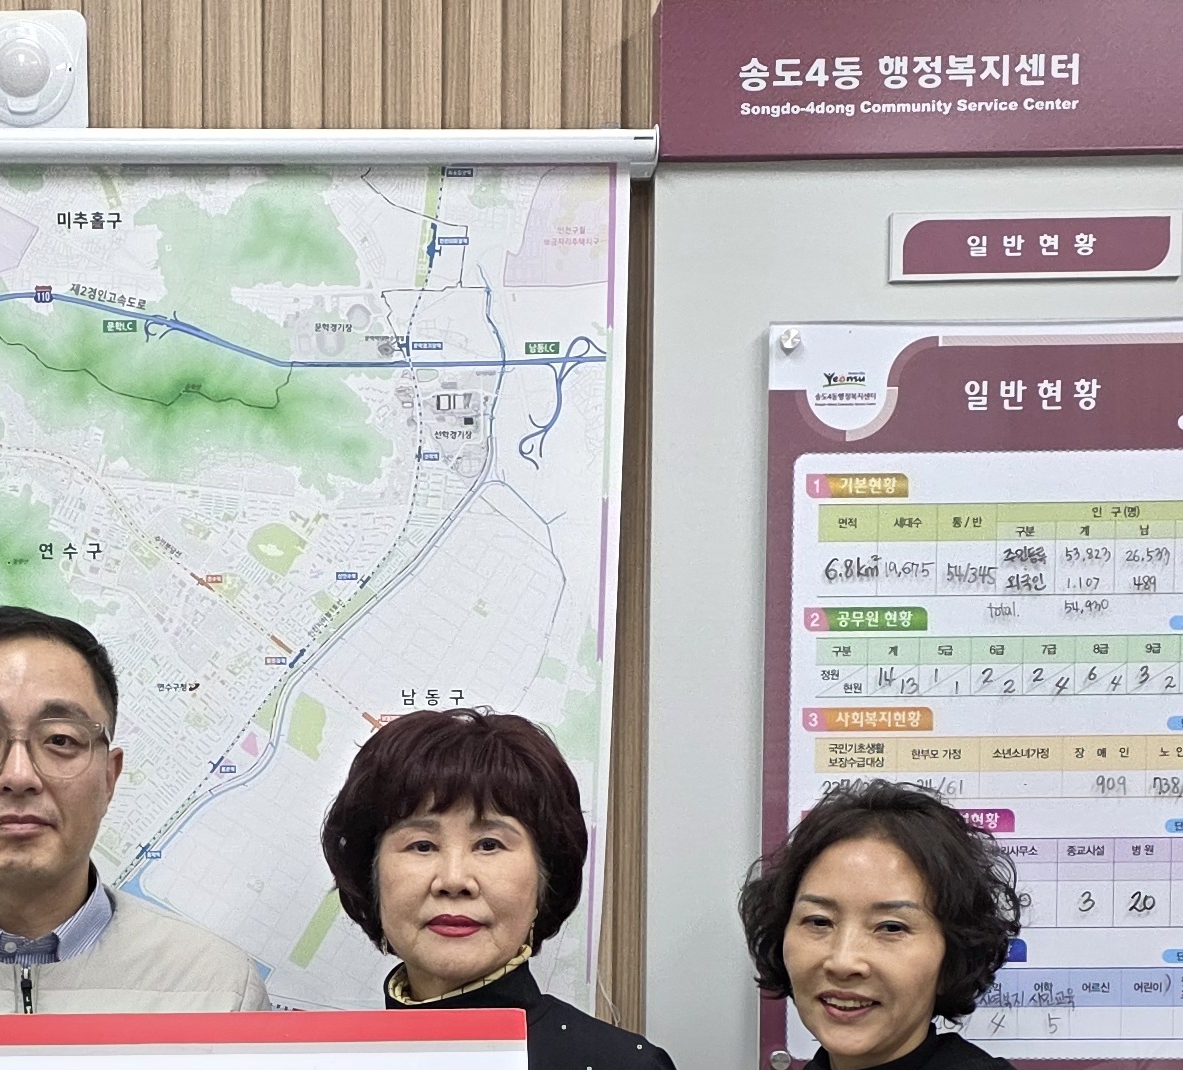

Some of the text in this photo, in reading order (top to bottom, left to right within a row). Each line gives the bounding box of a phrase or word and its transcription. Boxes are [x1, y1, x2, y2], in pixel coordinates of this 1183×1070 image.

[739, 52, 1081, 91] 송도4동 행정복지센터
[740, 97, 1080, 118] Songdo-4dong Community Service Center
[57, 211, 122, 230] 미추홀구
[36, 291, 51, 302] 110
[813, 476, 897, 494] 1 기본현황
[838, 518, 858, 528] 면적
[894, 517, 923, 528] 세대수
[1015, 525, 1036, 537] 구분
[1079, 525, 1090, 536] 계
[1133, 575, 1156, 592] 489
[810, 610, 914, 628] 2 공무원 현황
[832, 646, 852, 657] 구분
[989, 644, 1005, 655] 6급
[1042, 644, 1057, 655] 7급
[1093, 643, 1109, 654] 8급
[1145, 643, 1161, 654] 9급
[820, 669, 840, 680] 정원
[981, 667, 994, 684] 2
[1032, 667, 1044, 682] 2
[1088, 666, 1097, 681] 6
[1139, 665, 1150, 684] 3
[844, 683, 863, 694] 현원
[1003, 679, 1016, 693] 2
[1055, 676, 1070, 695] 4
[1111, 675, 1122, 691] 4
[1165, 676, 1176, 689] 2
[808, 711, 921, 728] 3 사회복지현황
[828, 743, 885, 754] 국민기초생활
[911, 748, 939, 759] 한부모
[942, 748, 962, 759] 가정
[992, 748, 1049, 759] 소년소녀가정
[828, 757, 884, 769] 보장수급대상
[1096, 775, 1127, 796] 909
[1079, 891, 1095, 912] 3
[1129, 890, 1155, 912] 20
[1082, 982, 1110, 993] 어르신
[1133, 981, 1162, 993] 어린이
[991, 1012, 1061, 1035] 4 5
